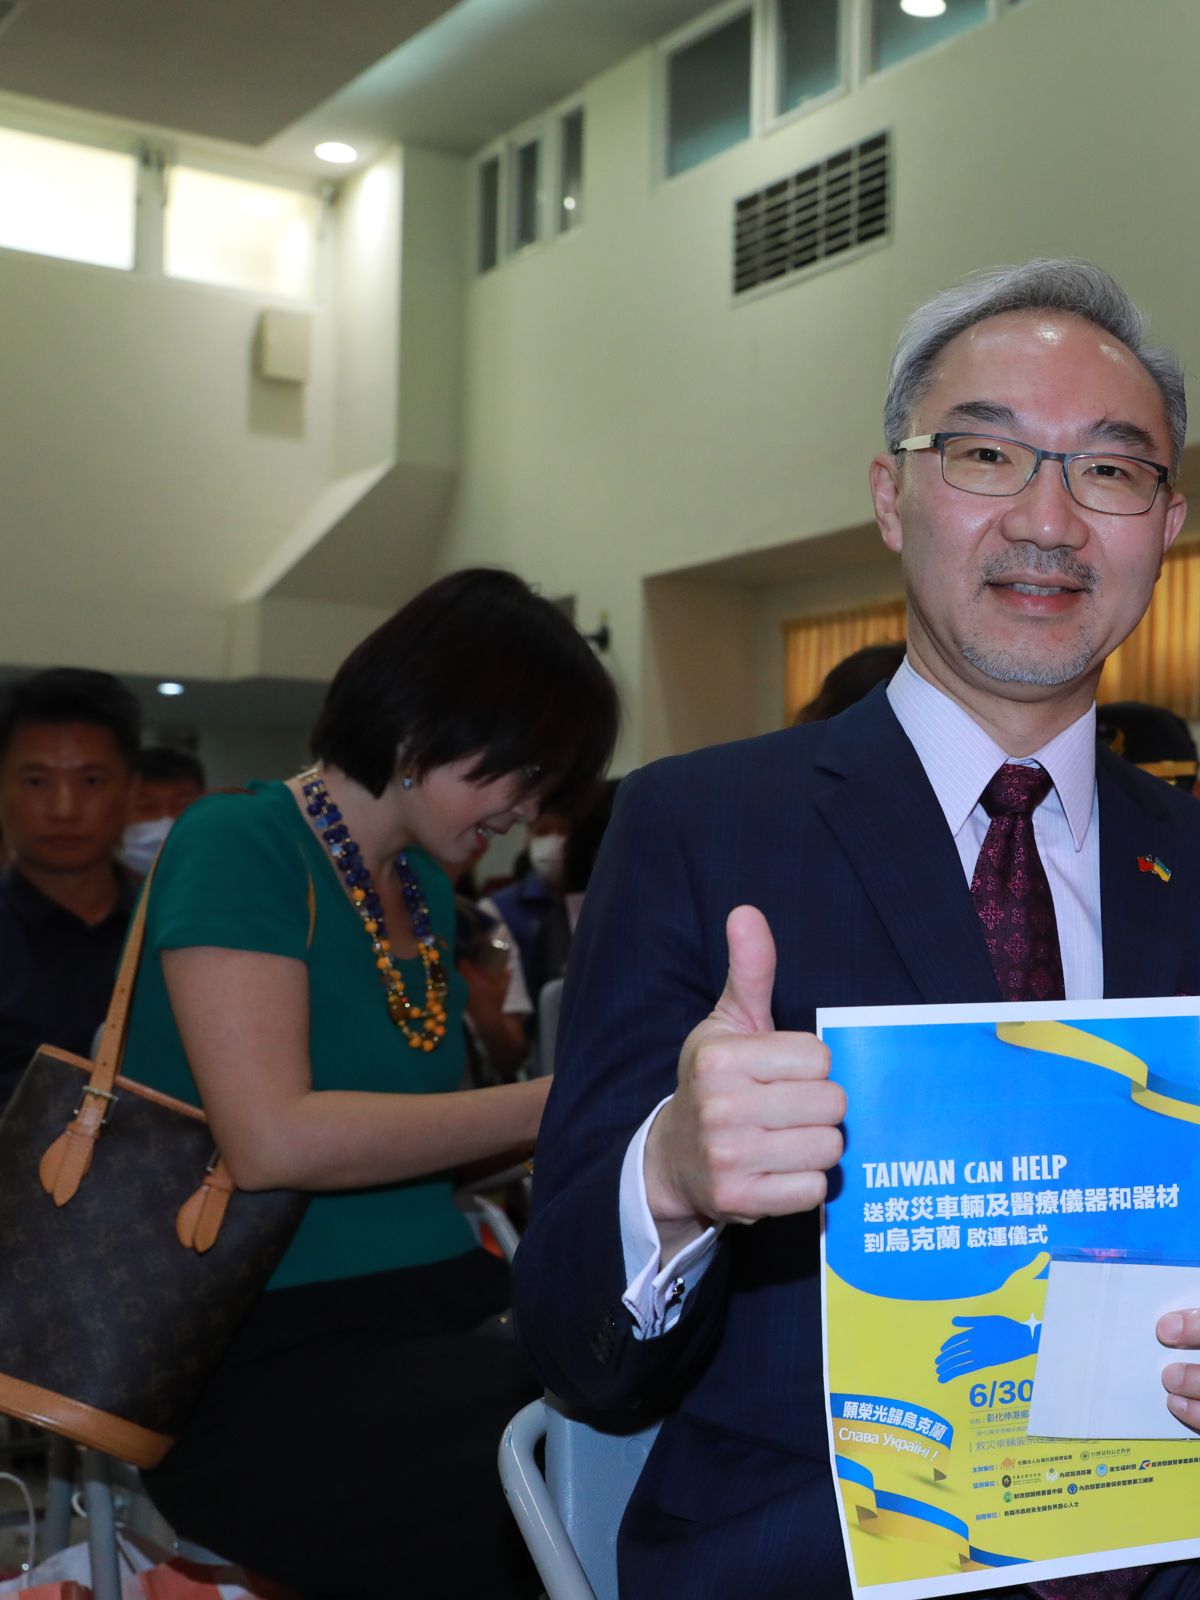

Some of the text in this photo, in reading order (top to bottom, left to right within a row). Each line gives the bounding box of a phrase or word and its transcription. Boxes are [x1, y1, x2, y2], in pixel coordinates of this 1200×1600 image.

[862, 1154, 1068, 1188] TAIWAN CAN HELP
[863, 1183, 1179, 1223] 送救災車輛及醫療儀器和器材
[863, 1225, 961, 1253] 到烏克蘭
[969, 1379, 1034, 1408] 6/30
[838, 1427, 879, 1444] Слава
[842, 1400, 948, 1441] 願榮光歸烏克蘭
